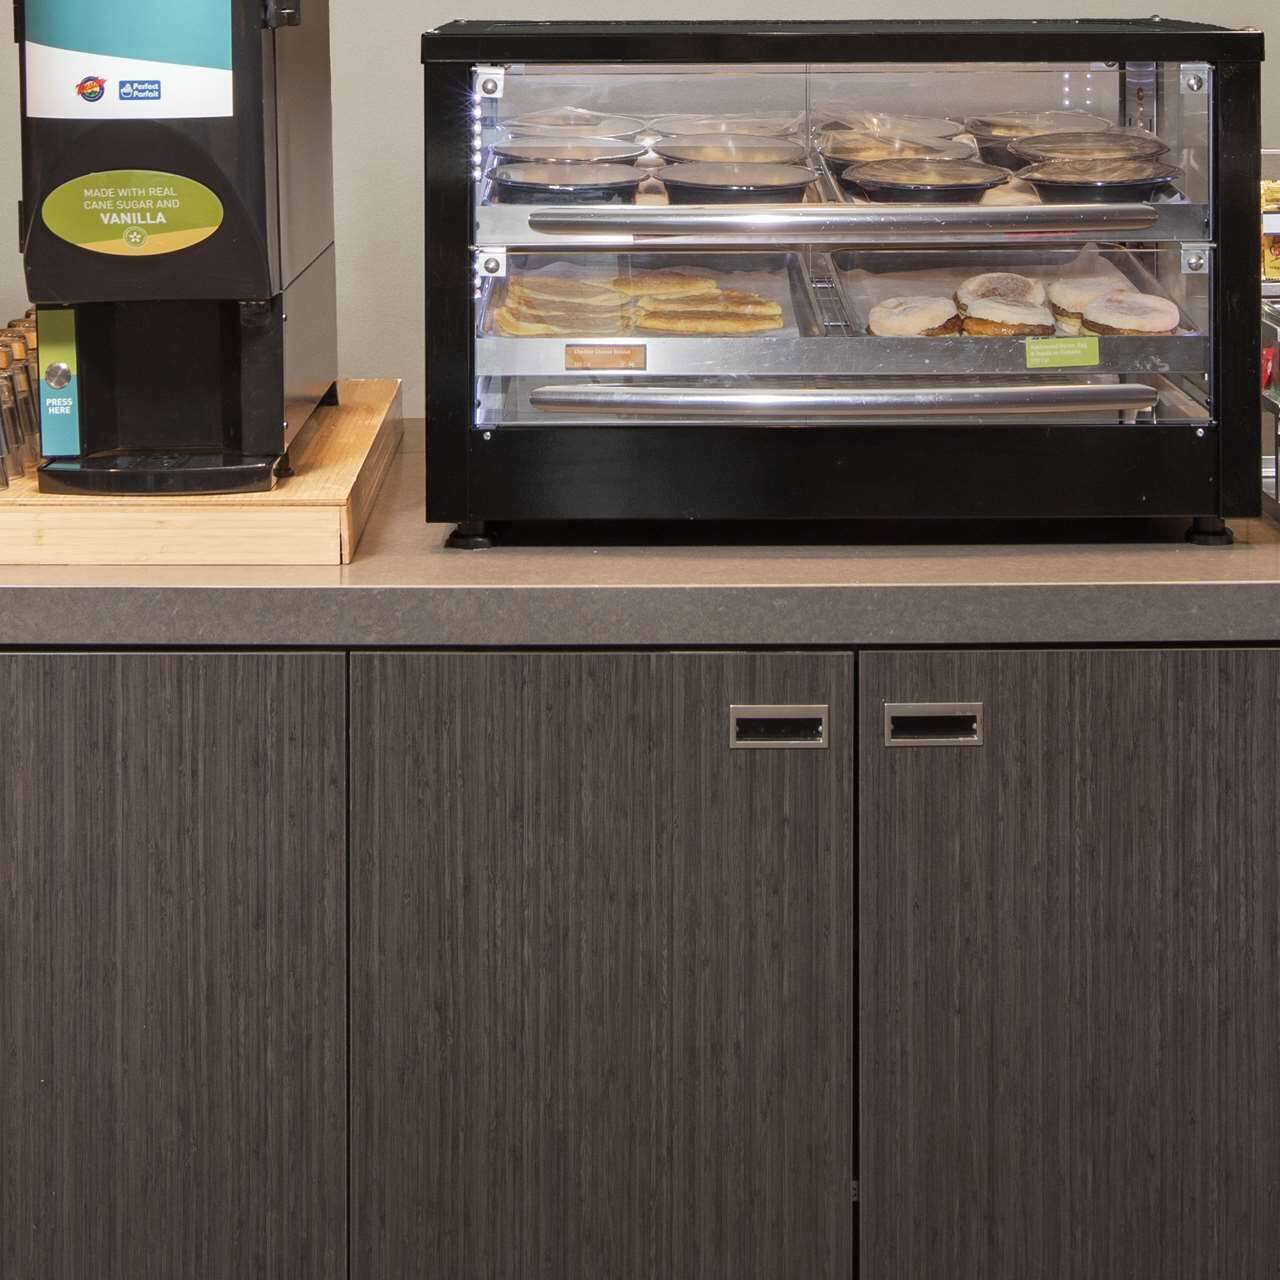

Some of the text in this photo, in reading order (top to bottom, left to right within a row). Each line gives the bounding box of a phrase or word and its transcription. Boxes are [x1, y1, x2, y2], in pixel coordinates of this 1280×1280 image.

[84, 186, 177, 198] MADE WITH REAL
[84, 199, 180, 210] CANE SUGAR AND
[100, 211, 167, 224] VANILLA
[46, 398, 72, 407] PRESS
[48, 407, 70, 415] HERE
